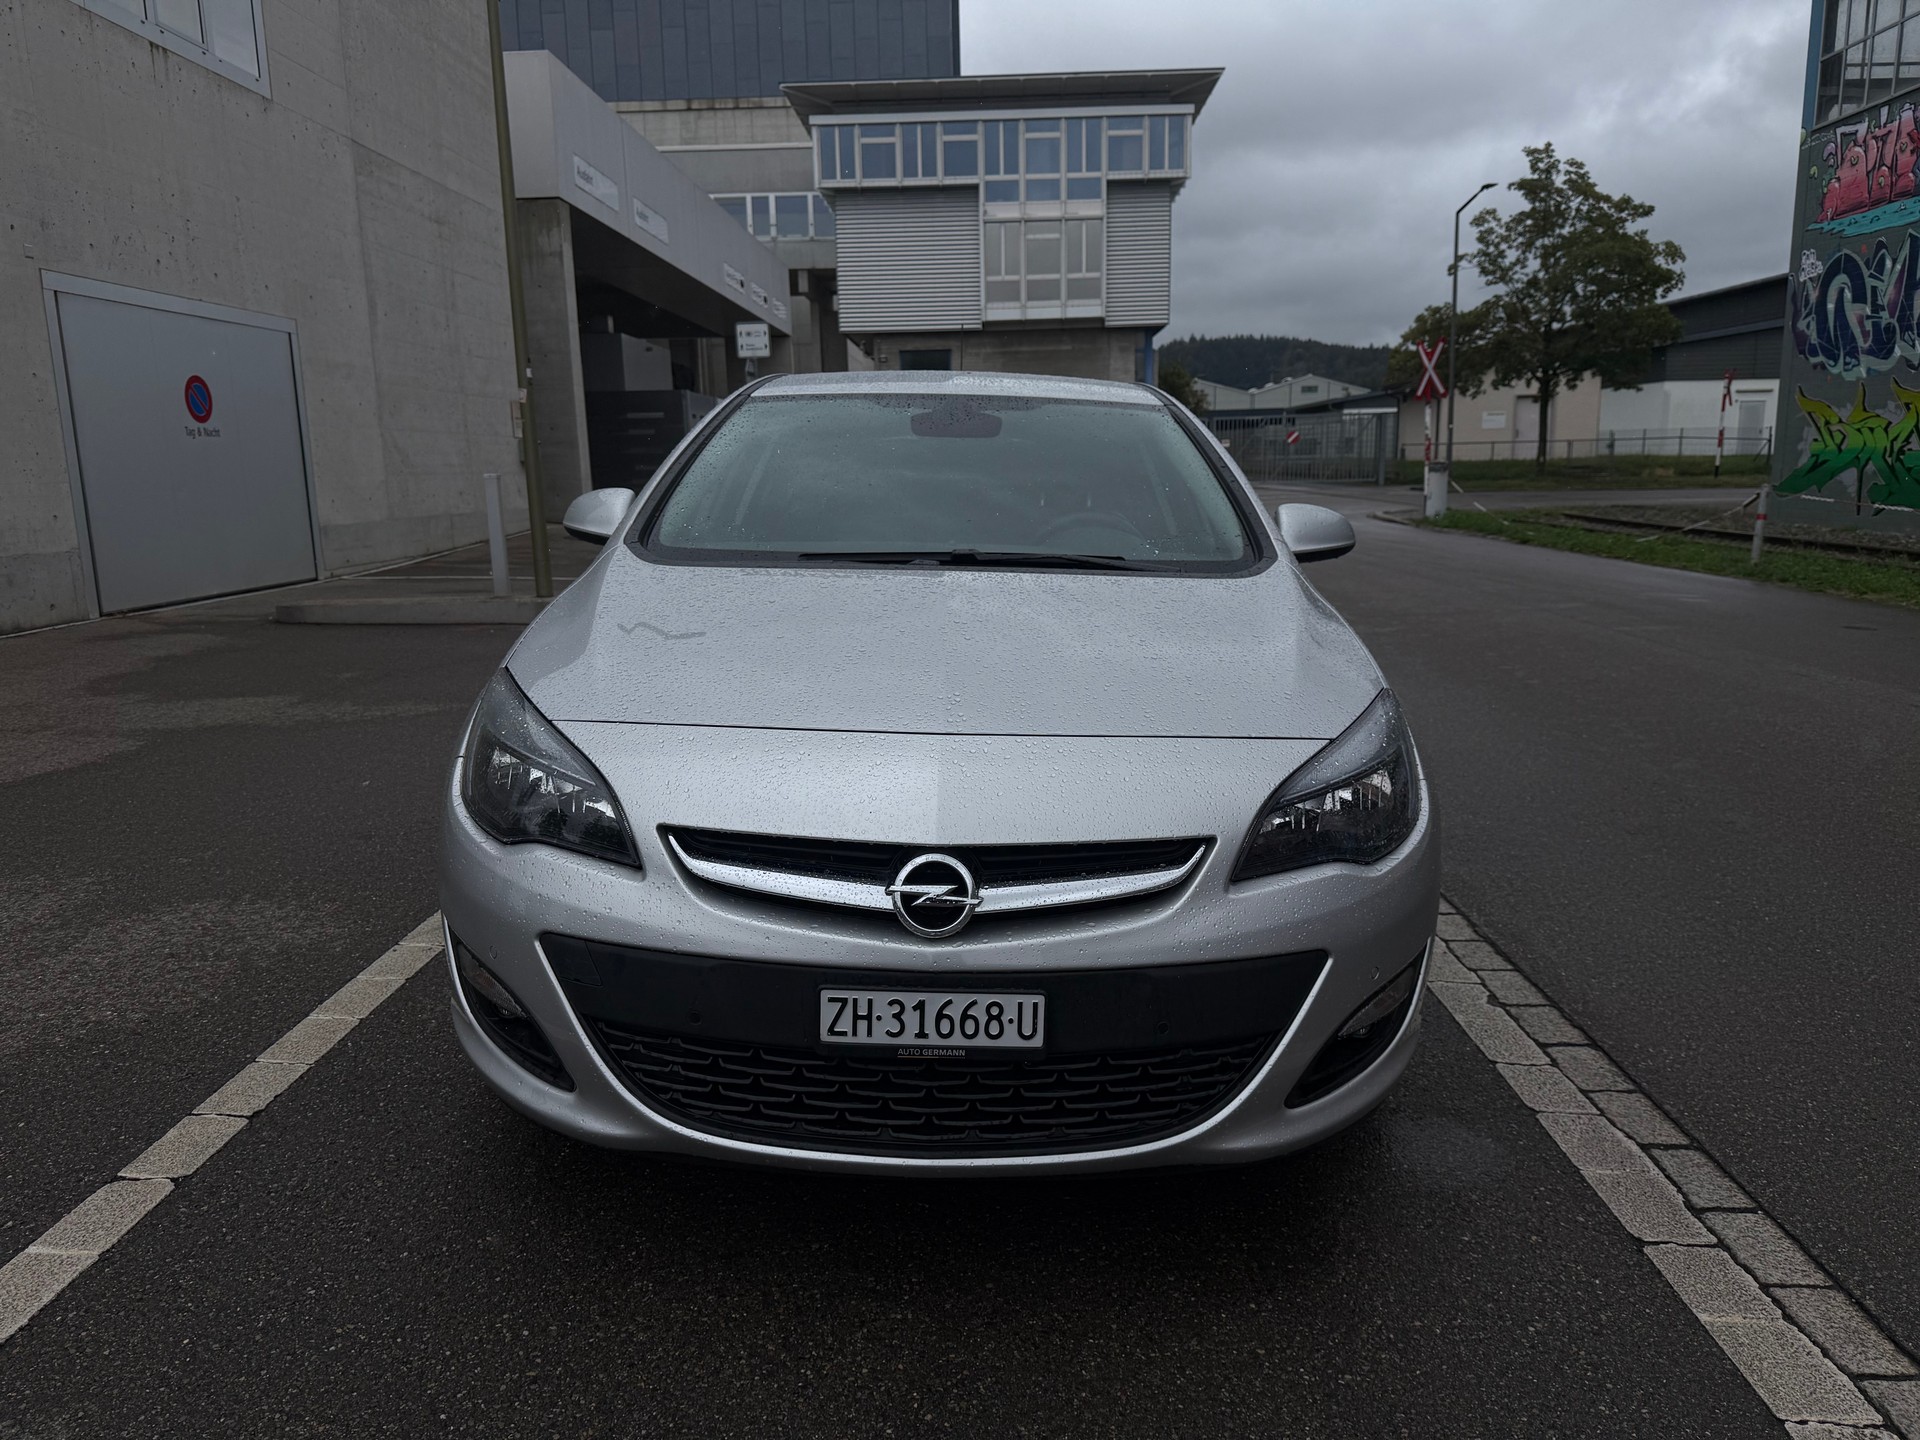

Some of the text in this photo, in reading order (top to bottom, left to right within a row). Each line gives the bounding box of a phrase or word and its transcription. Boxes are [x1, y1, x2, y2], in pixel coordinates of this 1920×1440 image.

[184, 426, 196, 440] Tag
[203, 427, 221, 437] Nacht
[897, 1048, 966, 1057] AUTO GERMANN
